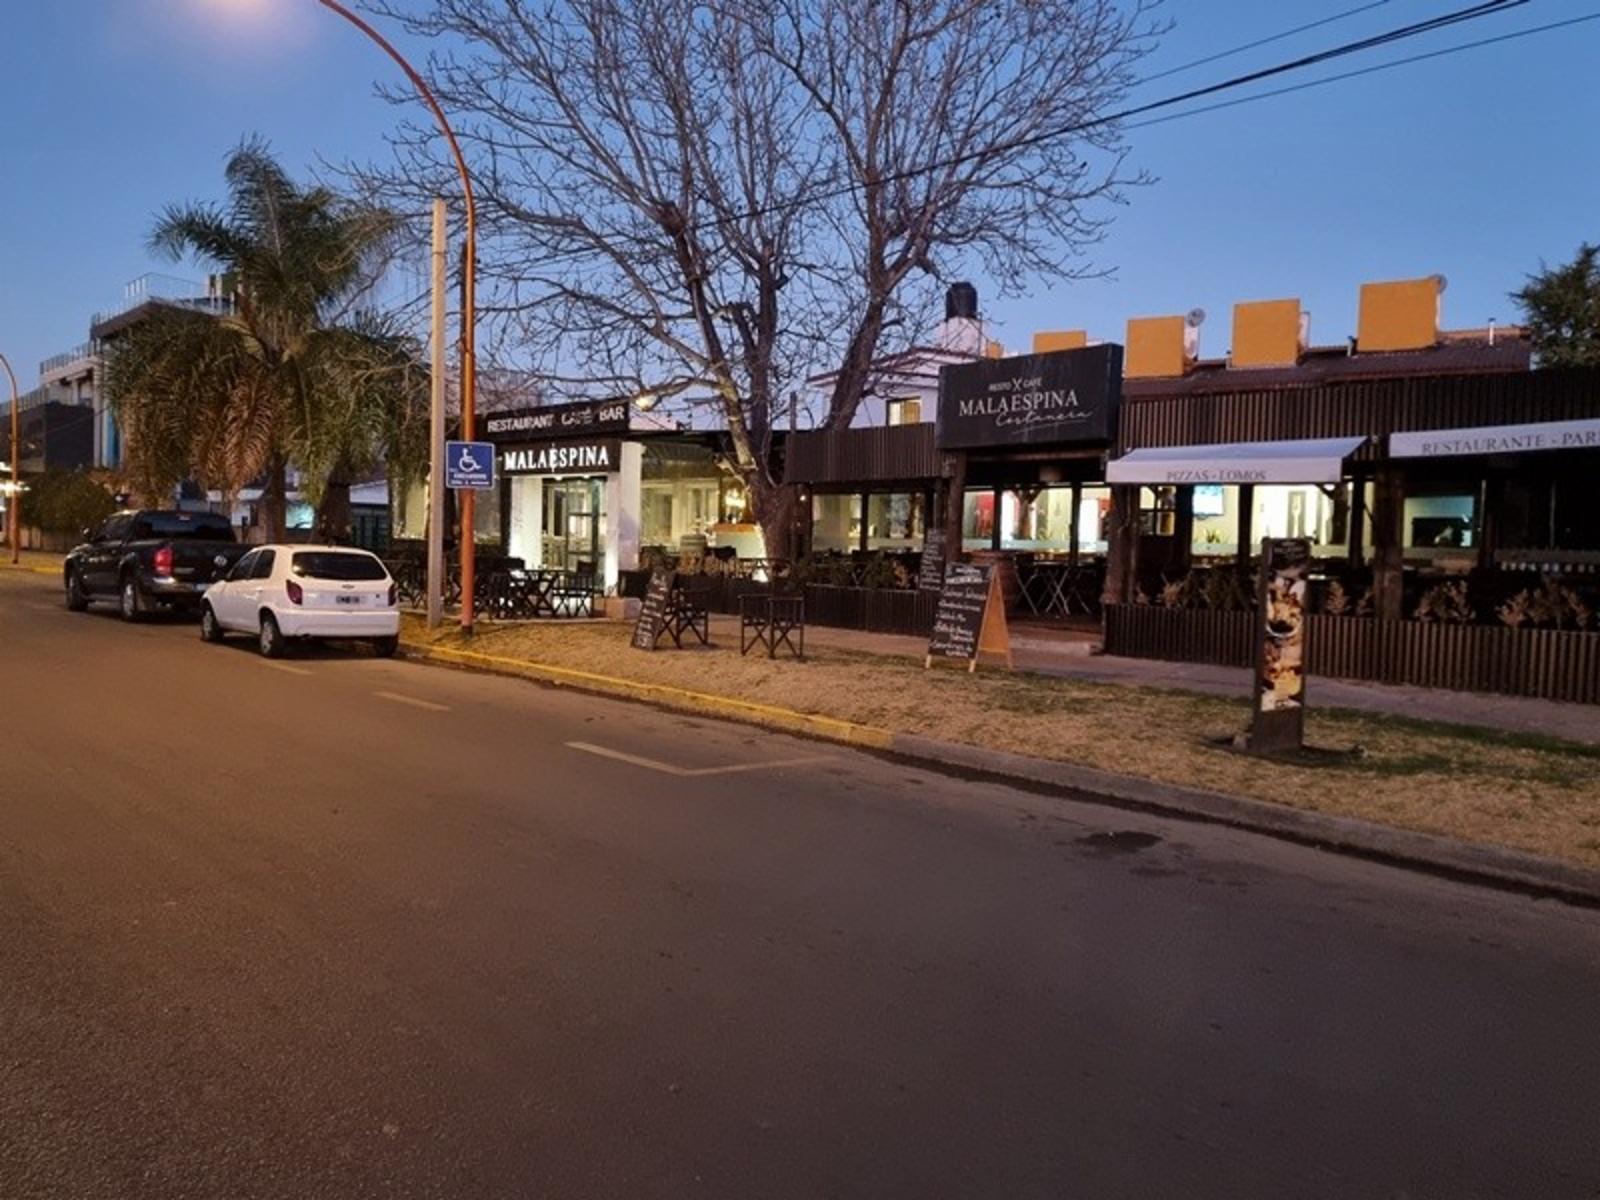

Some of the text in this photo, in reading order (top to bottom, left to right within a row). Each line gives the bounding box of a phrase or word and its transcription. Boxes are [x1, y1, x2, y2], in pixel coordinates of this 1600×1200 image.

[958, 389, 1079, 417] MALAESPINA
[487, 414, 553, 432] RESTAURANT
[600, 405, 625, 421] BAR
[1421, 434, 1545, 455] RESTAURANTE
[1562, 430, 1600, 446] PAR
[504, 445, 609, 471] MALAESPINA
[1166, 470, 1209, 482] PIZZAS
[1220, 469, 1267, 481] LOMOS
